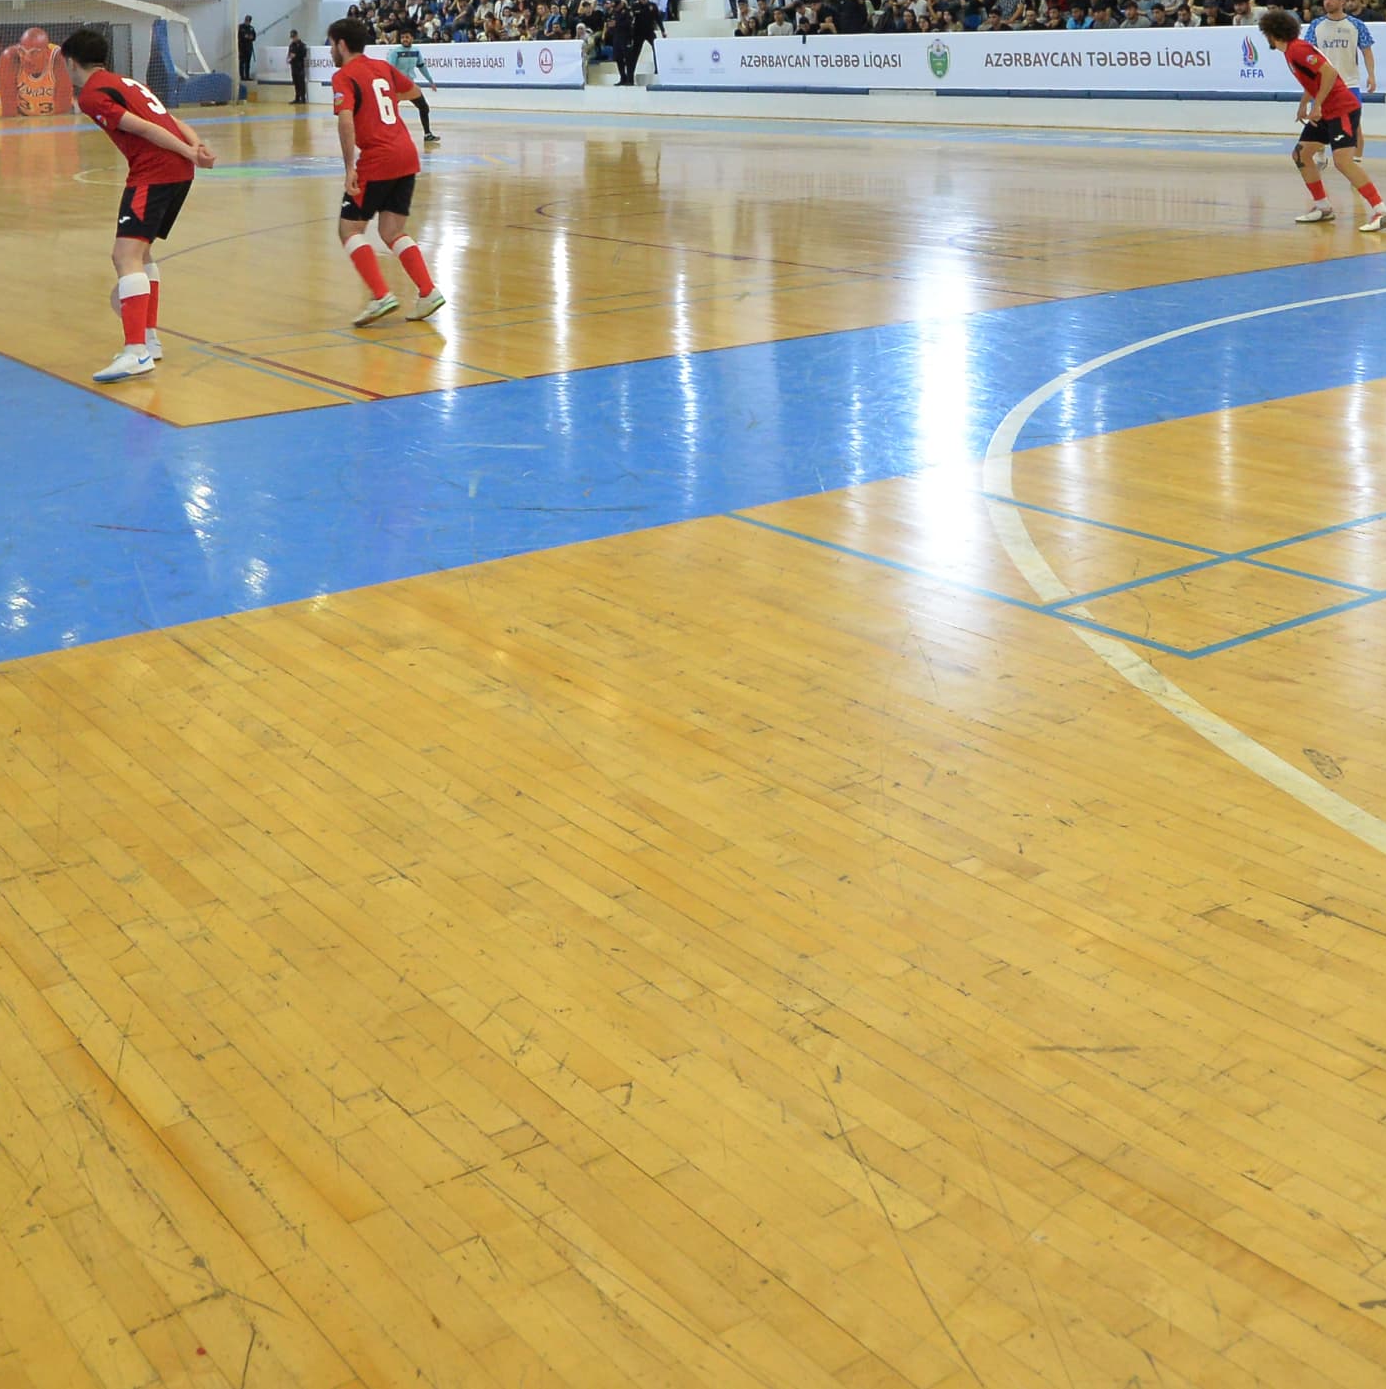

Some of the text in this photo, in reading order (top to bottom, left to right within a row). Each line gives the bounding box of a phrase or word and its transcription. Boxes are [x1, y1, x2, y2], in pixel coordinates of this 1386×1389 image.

[1322, 39, 1349, 49] AzTU
[740, 49, 902, 68] AZƏRBAYCAN TƏLƏBƏ LİQASI
[983, 46, 1211, 68] AZƏRBAYCAN TƏLƏBƏ LİQASI
[1240, 69, 1264, 79] AFFA
[120, 77, 168, 115] 3
[372, 78, 397, 125] 6
